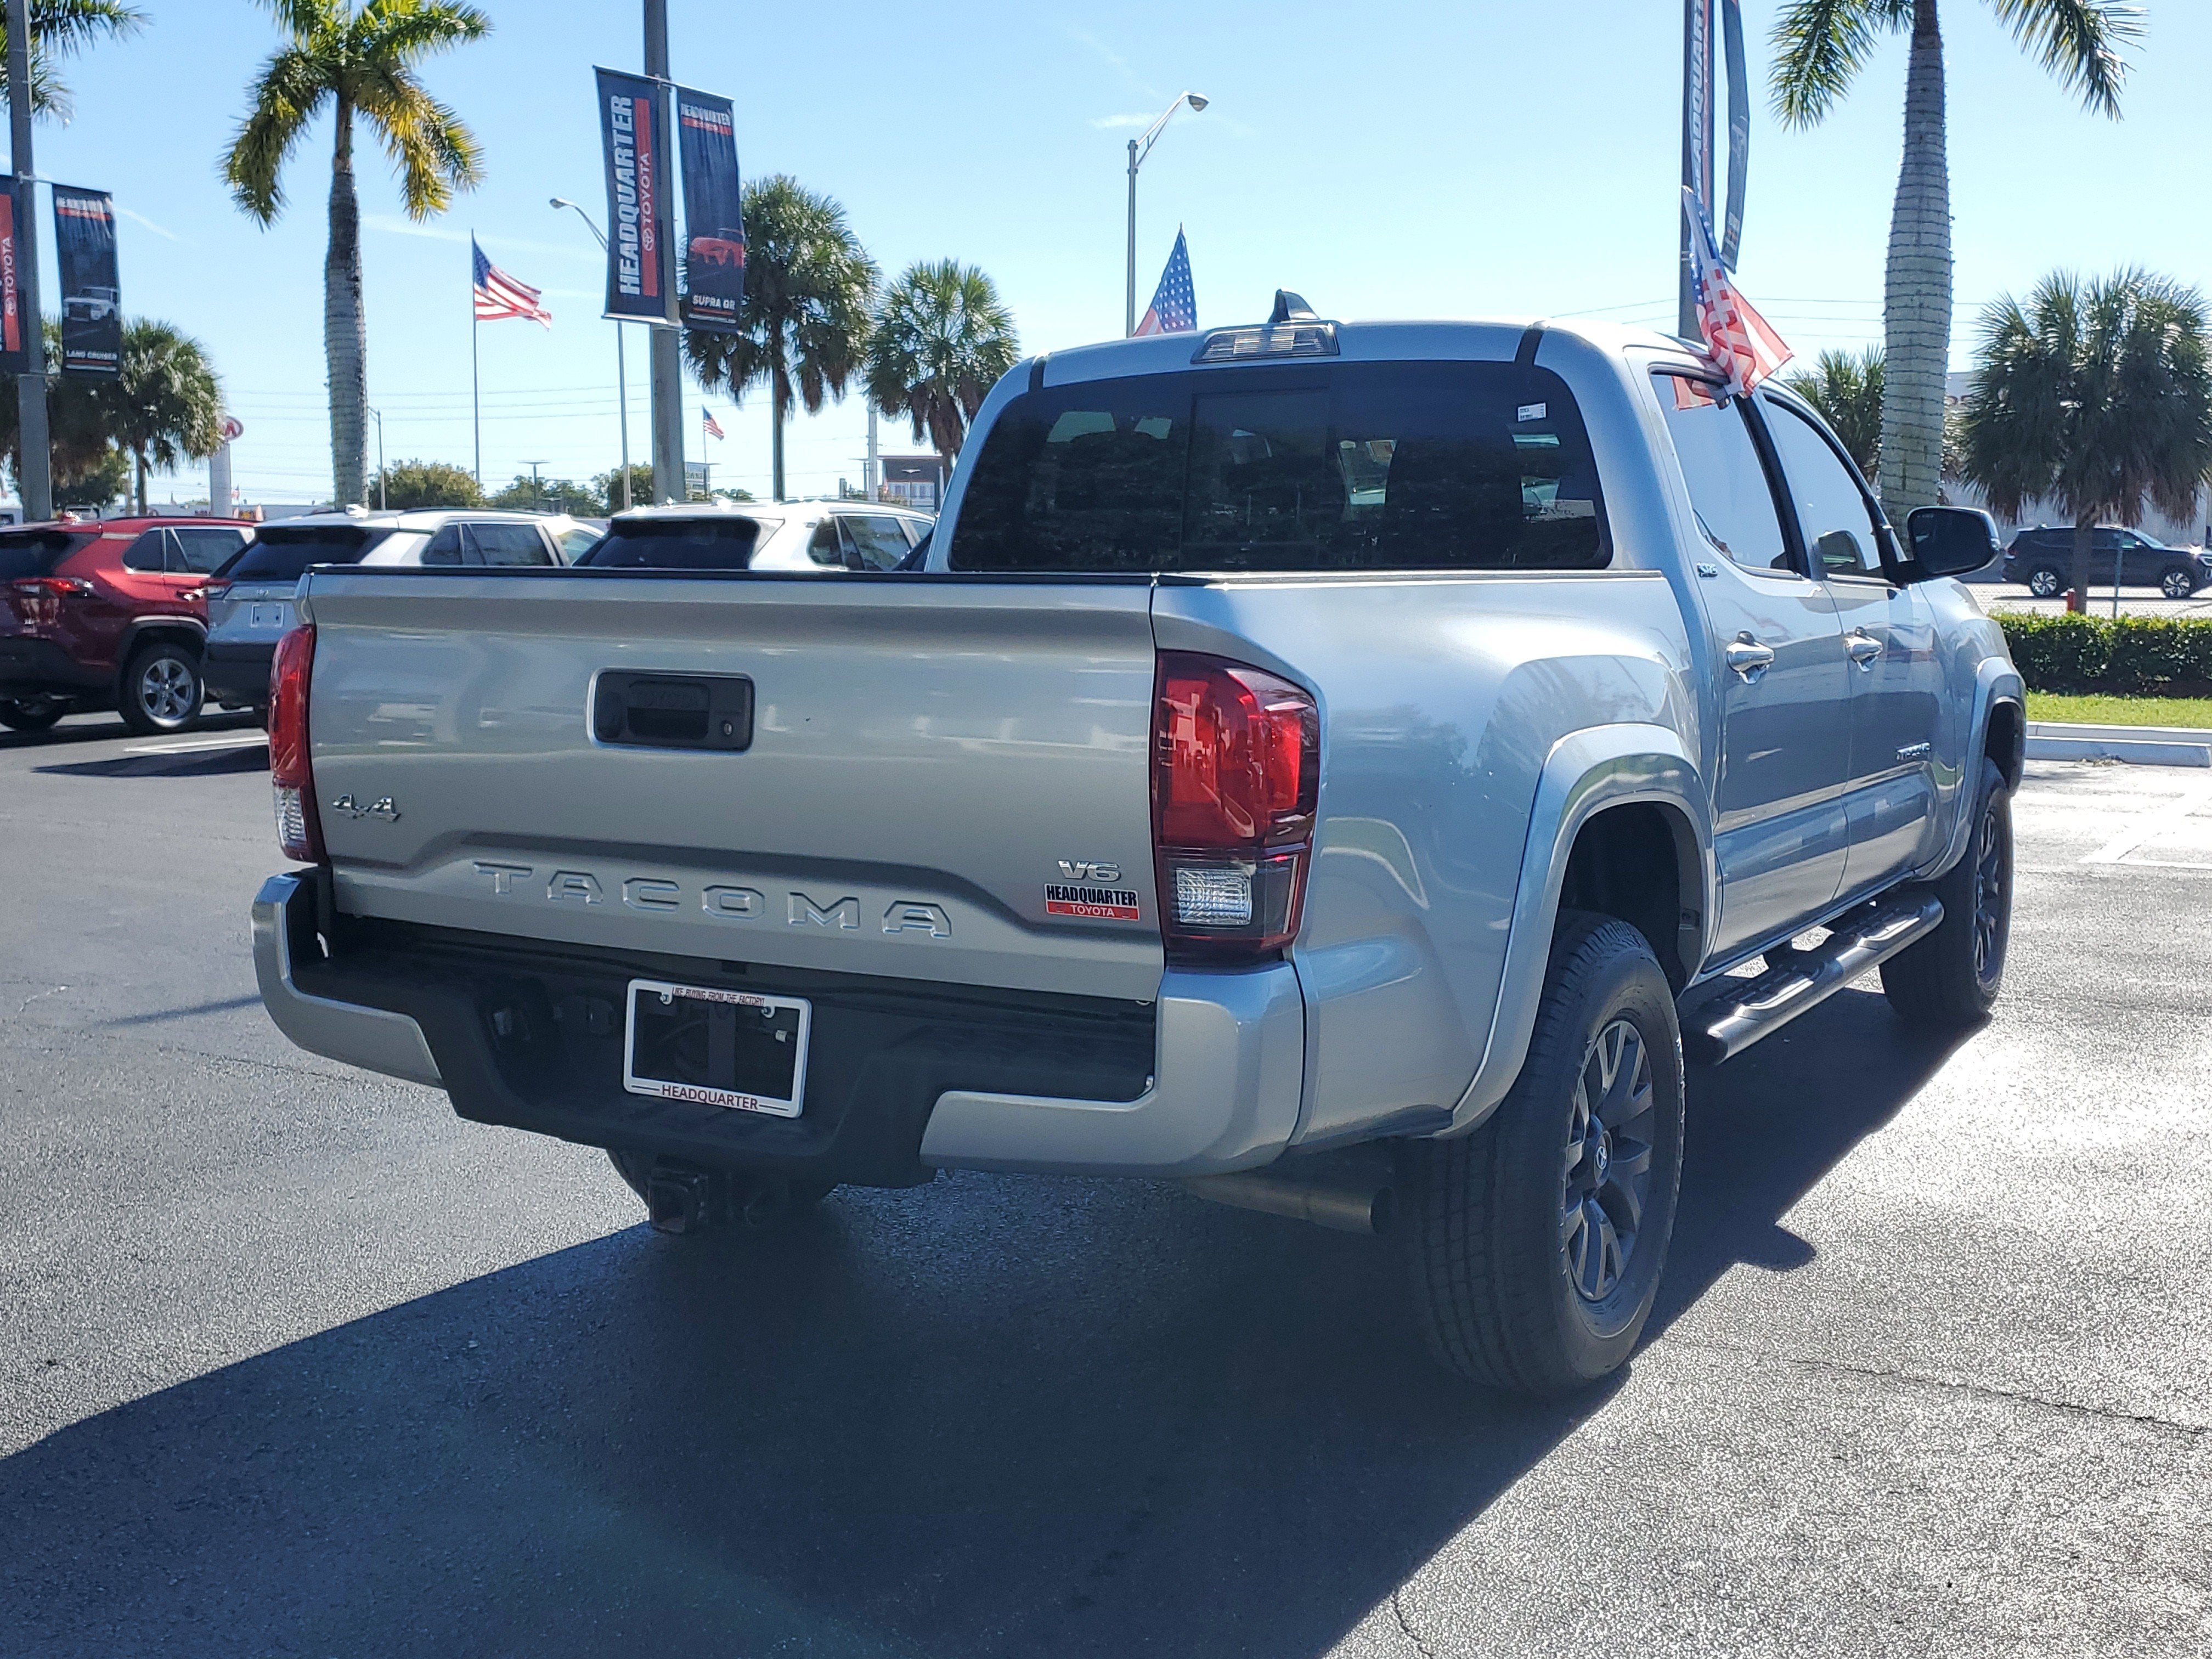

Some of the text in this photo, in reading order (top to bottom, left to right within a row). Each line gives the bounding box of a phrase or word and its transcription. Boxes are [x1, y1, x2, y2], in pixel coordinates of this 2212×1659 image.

[610, 94, 641, 295] HEADQUARTER
[640, 153, 653, 224] TOYOTA
[2, 236, 15, 294] TOYOTA
[692, 295, 721, 308] SUPRA
[1057, 859, 1121, 882] V6
[471, 860, 953, 939] TACOMA
[1046, 884, 1137, 906] HEADQUARTER
[1070, 904, 1115, 917] TOYOTA
[726, 994, 737, 1004] THE
[662, 1084, 758, 1110] HEADQUARTER
